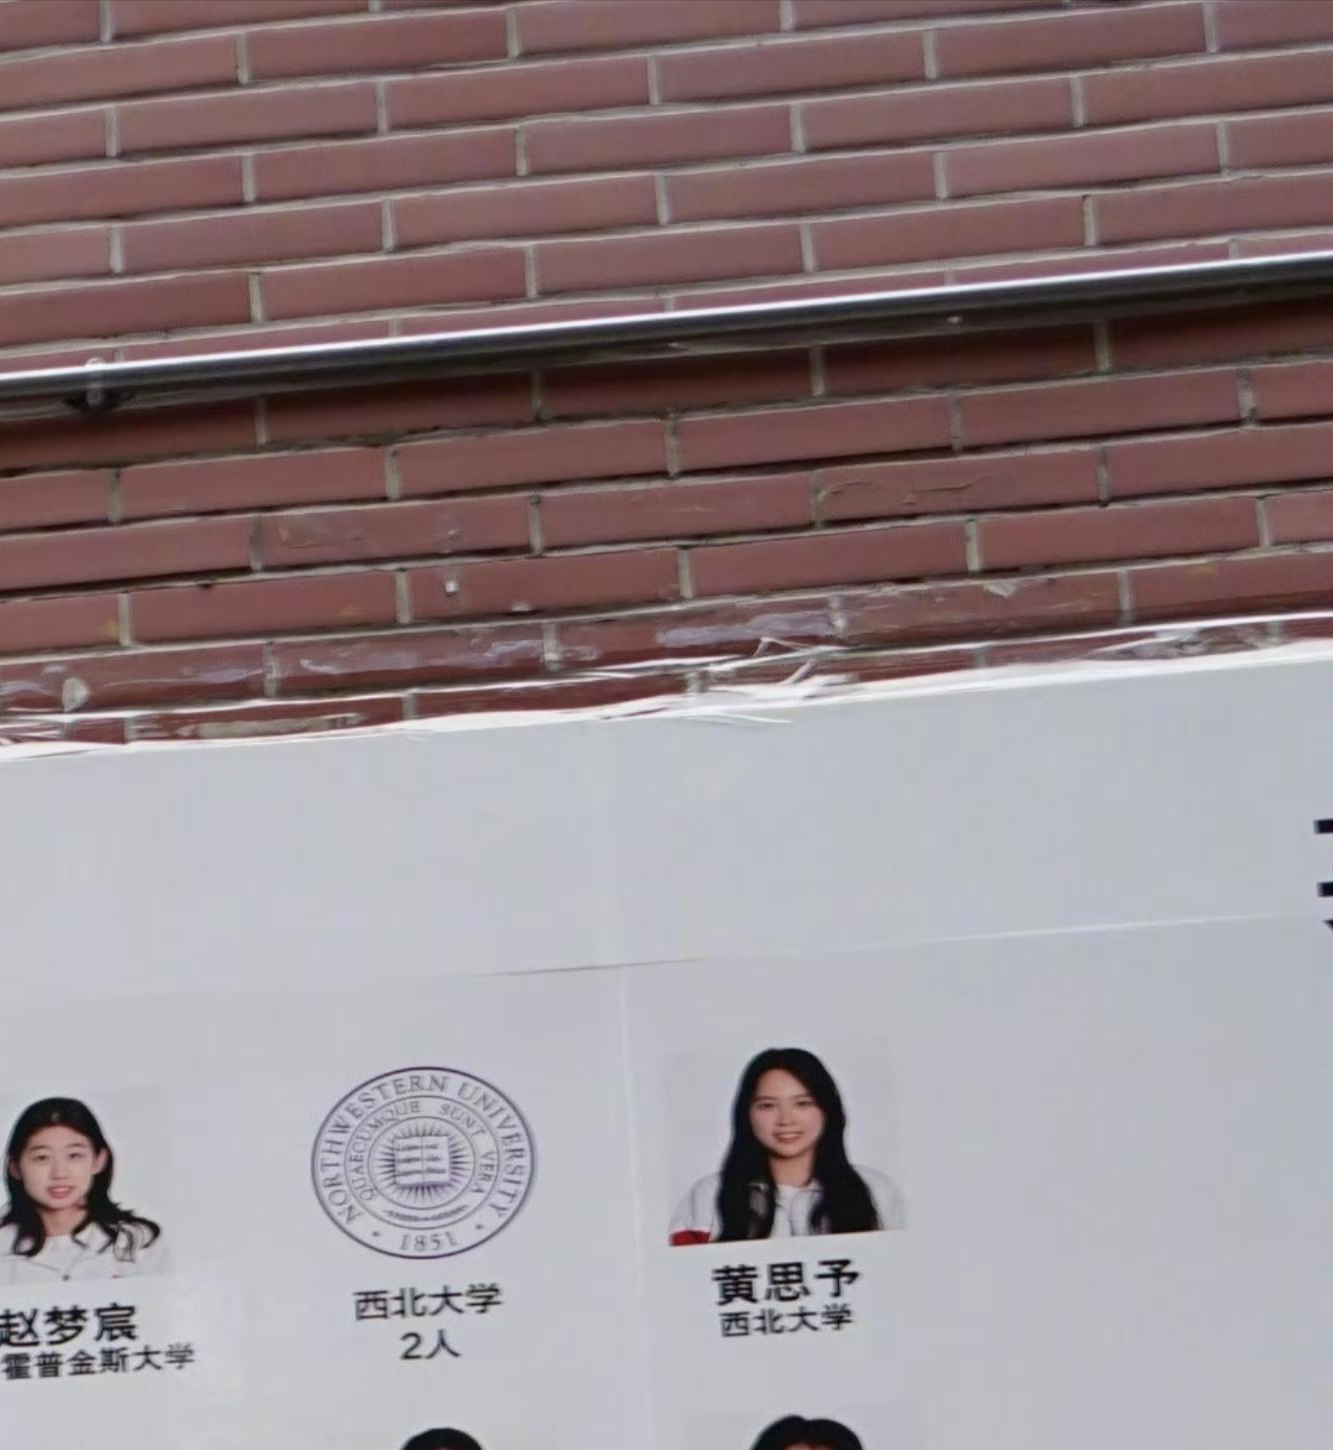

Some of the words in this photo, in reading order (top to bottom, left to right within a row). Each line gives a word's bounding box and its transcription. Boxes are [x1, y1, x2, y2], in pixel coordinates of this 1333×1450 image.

[319, 1074, 450, 1226] NORTHWESTERN
[456, 1081, 527, 1218] UNIVERSITY
[399, 1230, 460, 1252] 1851
[711, 1258, 861, 1307] 黄思予
[352, 1282, 504, 1322] 西北大学
[719, 1303, 853, 1338] 西北大学
[400, 1329, 461, 1361] 2人
